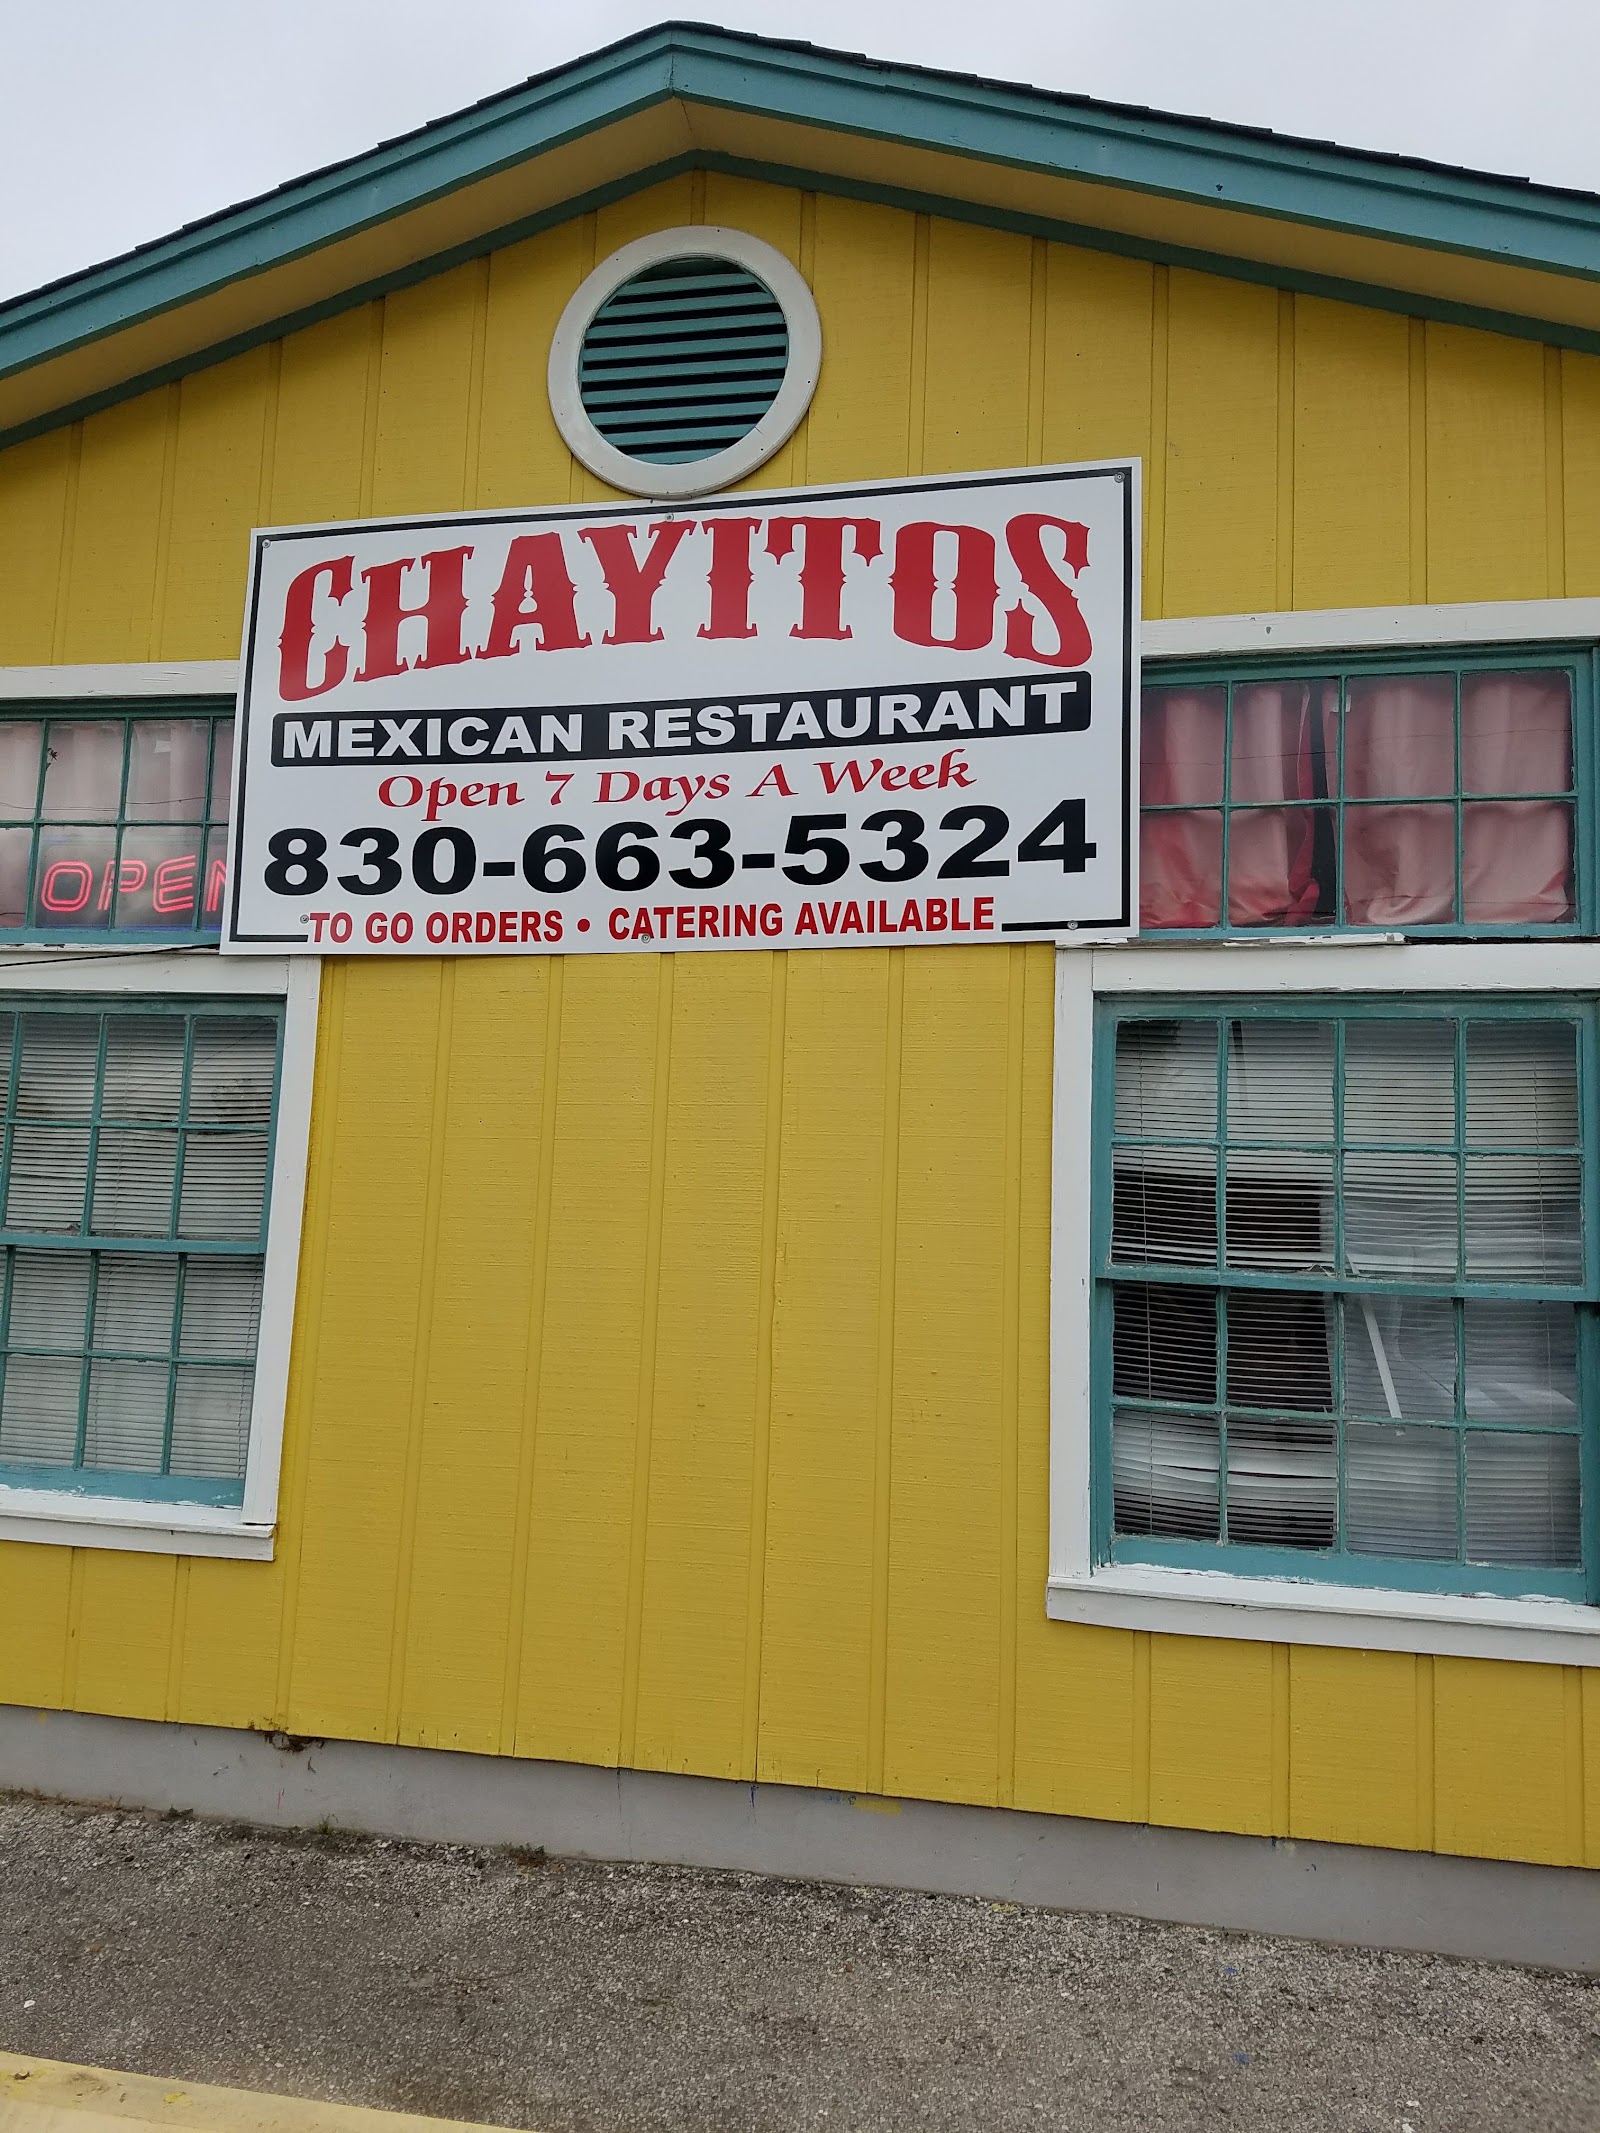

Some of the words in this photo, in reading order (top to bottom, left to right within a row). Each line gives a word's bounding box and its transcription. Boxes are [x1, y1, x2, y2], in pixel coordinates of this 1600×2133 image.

[277, 513, 1093, 701] CHAYITOS
[282, 713, 583, 759] MEXICAN
[608, 681, 1078, 752] RESTAURANT
[378, 774, 525, 822] Open
[545, 770, 575, 806] 7
[593, 770, 730, 817] Days
[745, 763, 799, 797] A
[813, 748, 978, 795] Week
[264, 798, 1097, 896] 830-663-5324
[309, 912, 353, 944] TO
[365, 912, 414, 944] GO
[426, 909, 563, 943] ORDERS
[608, 903, 783, 940] CATERING
[794, 896, 995, 935] AVAILABLE
